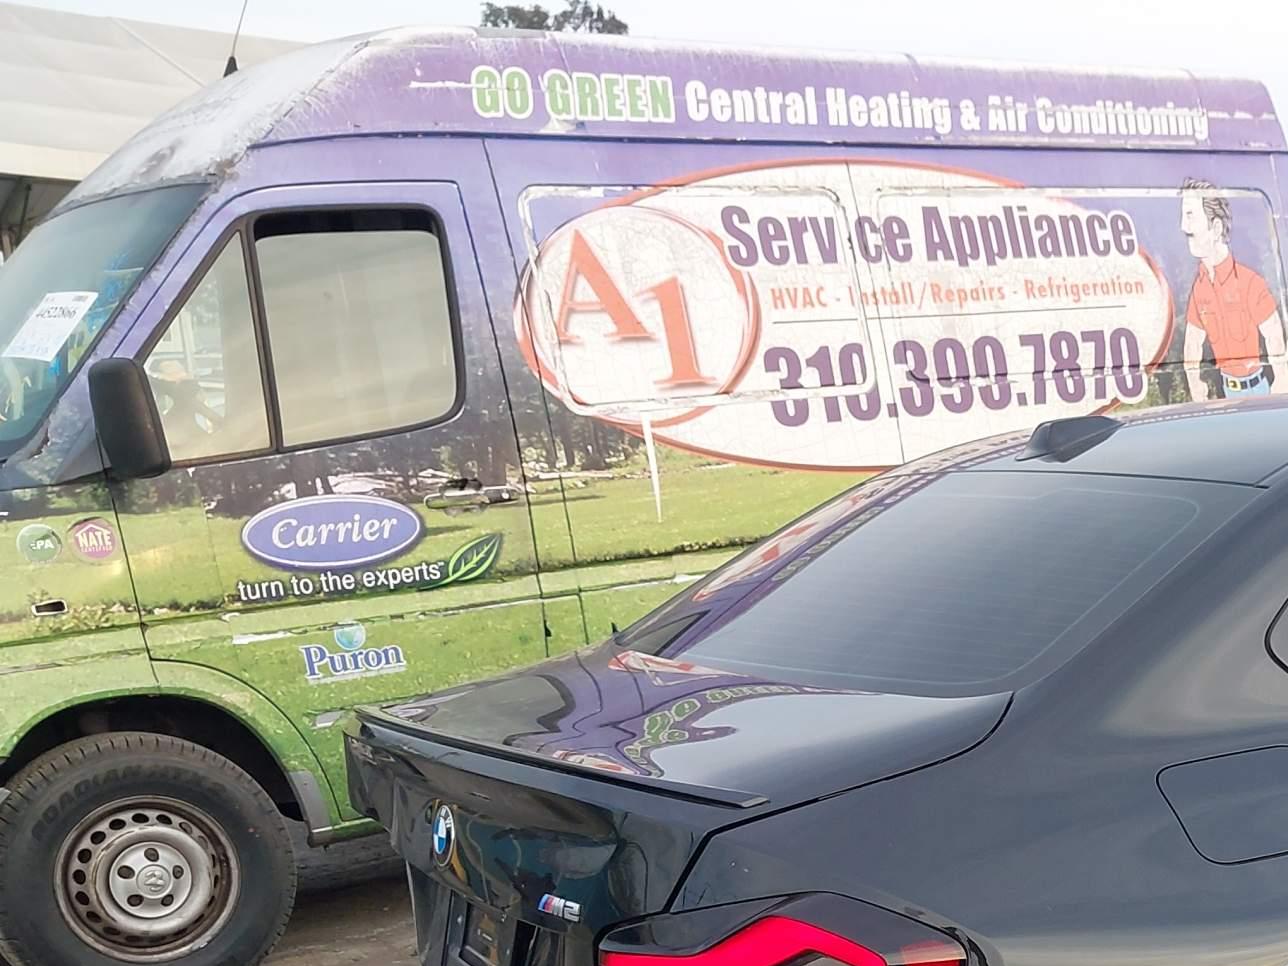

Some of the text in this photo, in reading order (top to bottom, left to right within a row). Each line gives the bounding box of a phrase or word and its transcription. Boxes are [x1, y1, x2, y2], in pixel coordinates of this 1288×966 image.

[471, 66, 1210, 141] GO GREEN Central Heating & Air Conditioning
[720, 205, 1137, 268] Servce Appliance
[557, 229, 717, 388] A1
[770, 285, 828, 311] HVAC
[1024, 276, 1145, 304] Refrigeration
[763, 327, 1144, 428] 310.390.7870
[78, 530, 112, 548] NATE
[271, 513, 398, 549] Carrier
[237, 580, 285, 602] turn
[290, 575, 314, 596] to
[320, 570, 356, 593] the
[301, 643, 407, 679] Puron
